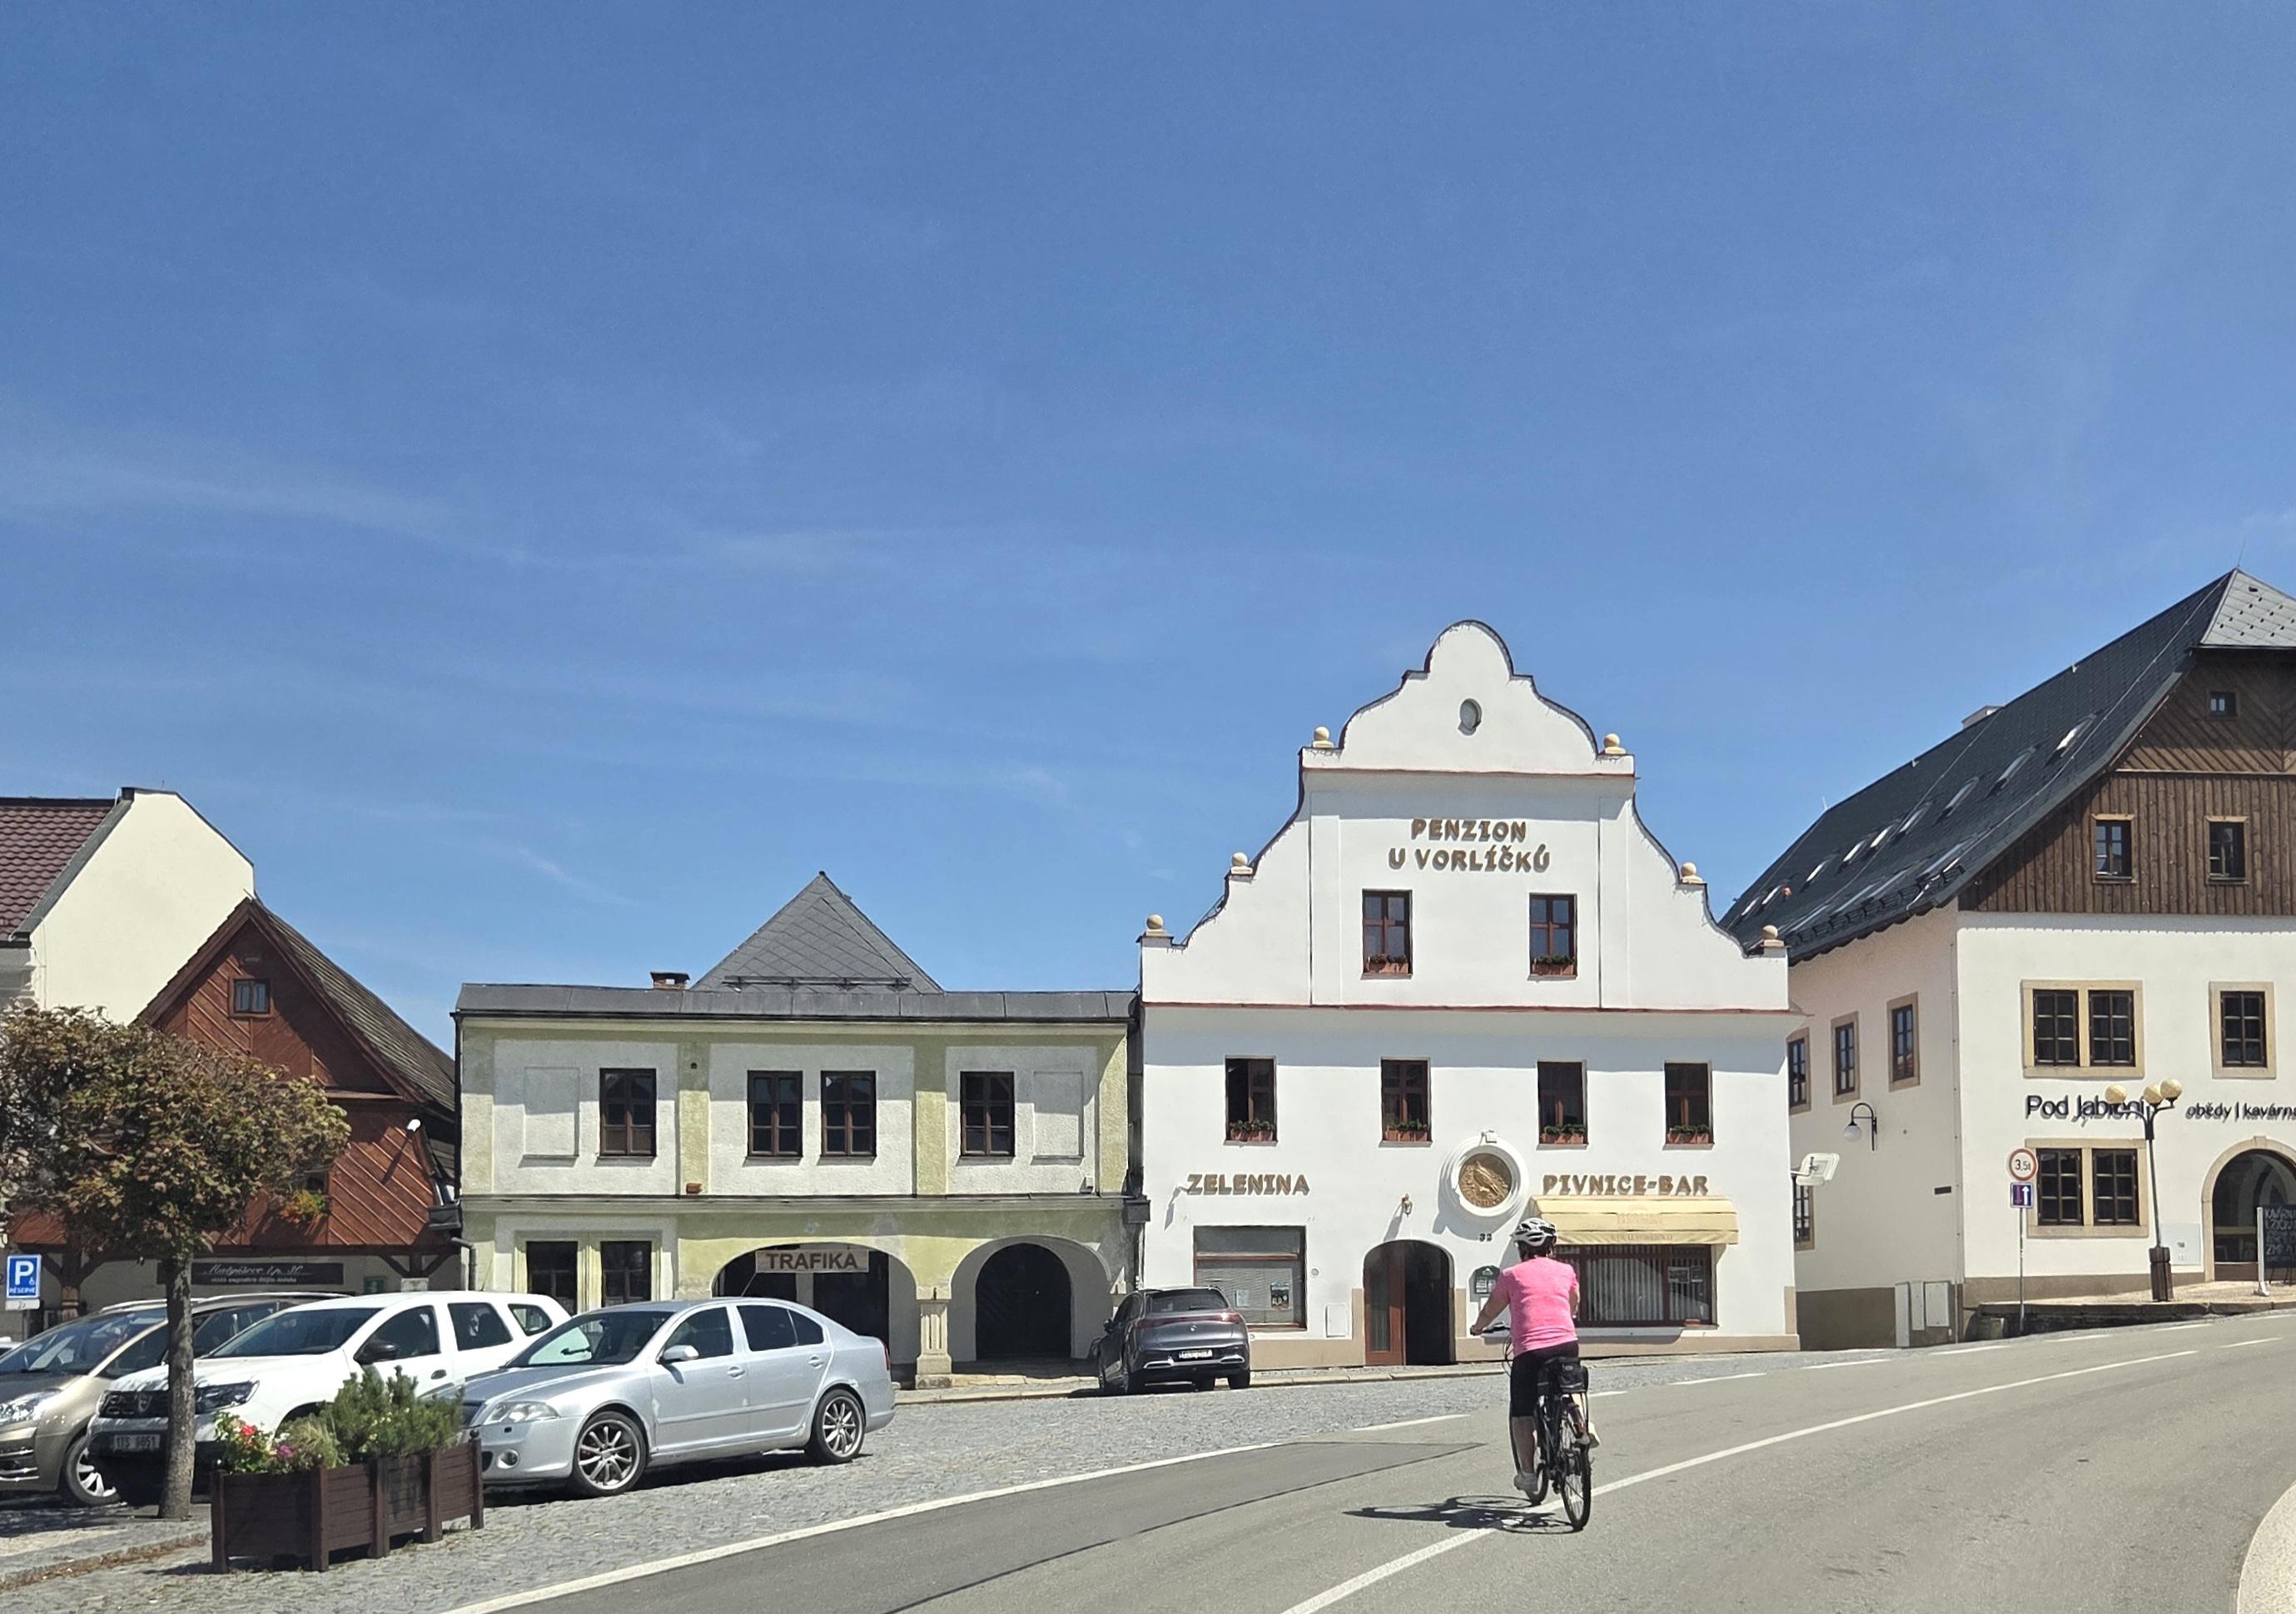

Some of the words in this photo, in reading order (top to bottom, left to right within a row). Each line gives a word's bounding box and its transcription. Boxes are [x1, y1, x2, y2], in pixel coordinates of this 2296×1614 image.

[1411, 818, 1527, 842] PENZION
[1389, 847, 1406, 870] U
[2025, 1095, 2070, 1118] Pod
[2186, 1102, 2232, 1122] obědy
[1187, 1174, 1310, 1195] ZELENINA
[1543, 1174, 1709, 1196] PIVNICE-BAR
[766, 1253, 858, 1269] TRAFIKA
[15, 1260, 34, 1285] P
